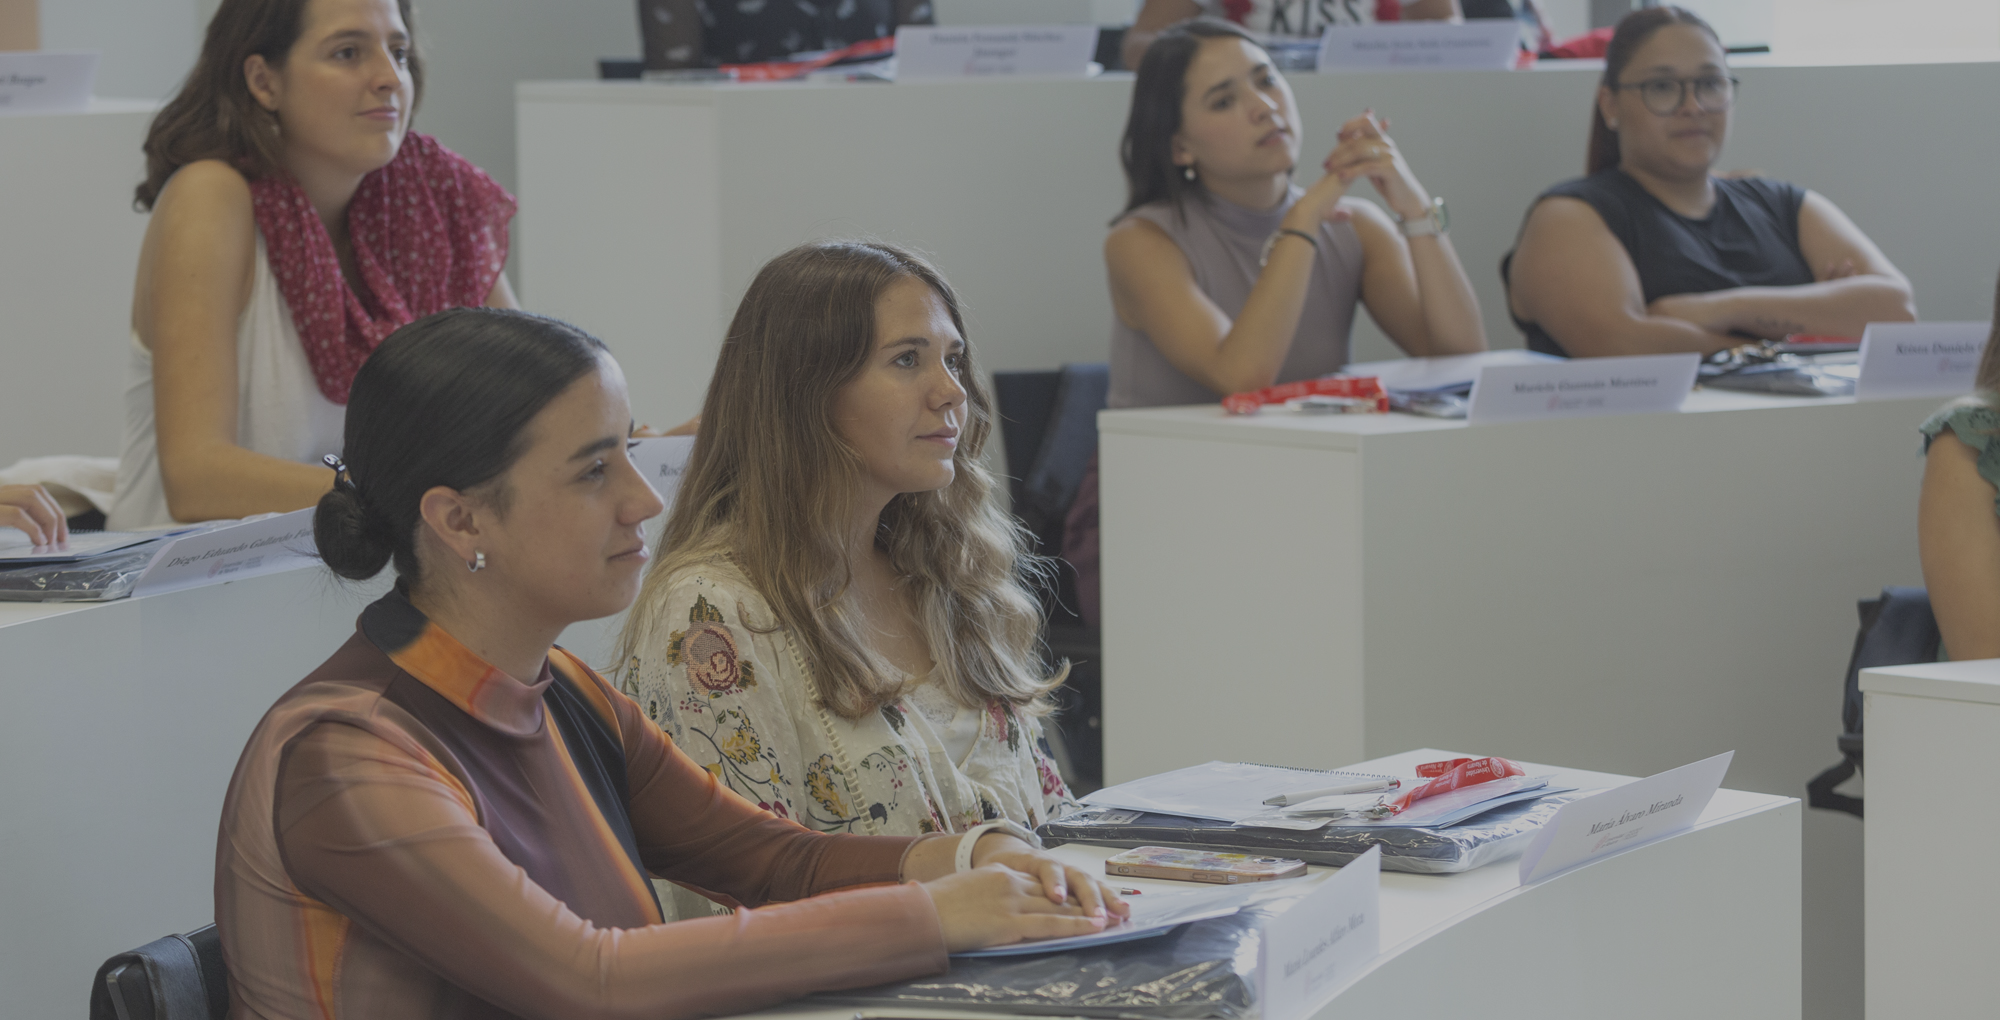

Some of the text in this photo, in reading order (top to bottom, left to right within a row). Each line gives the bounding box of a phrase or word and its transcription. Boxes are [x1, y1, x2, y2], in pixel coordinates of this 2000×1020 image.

[166, 528, 313, 568] Diego Eduardo Gallardo Fue
[1466, 767, 1490, 777] Universidad
[1467, 761, 1482, 769] Navarra
[1586, 817, 1616, 836] María
[1615, 809, 1646, 827] Álvaro
[1645, 793, 1684, 816] Miranda
